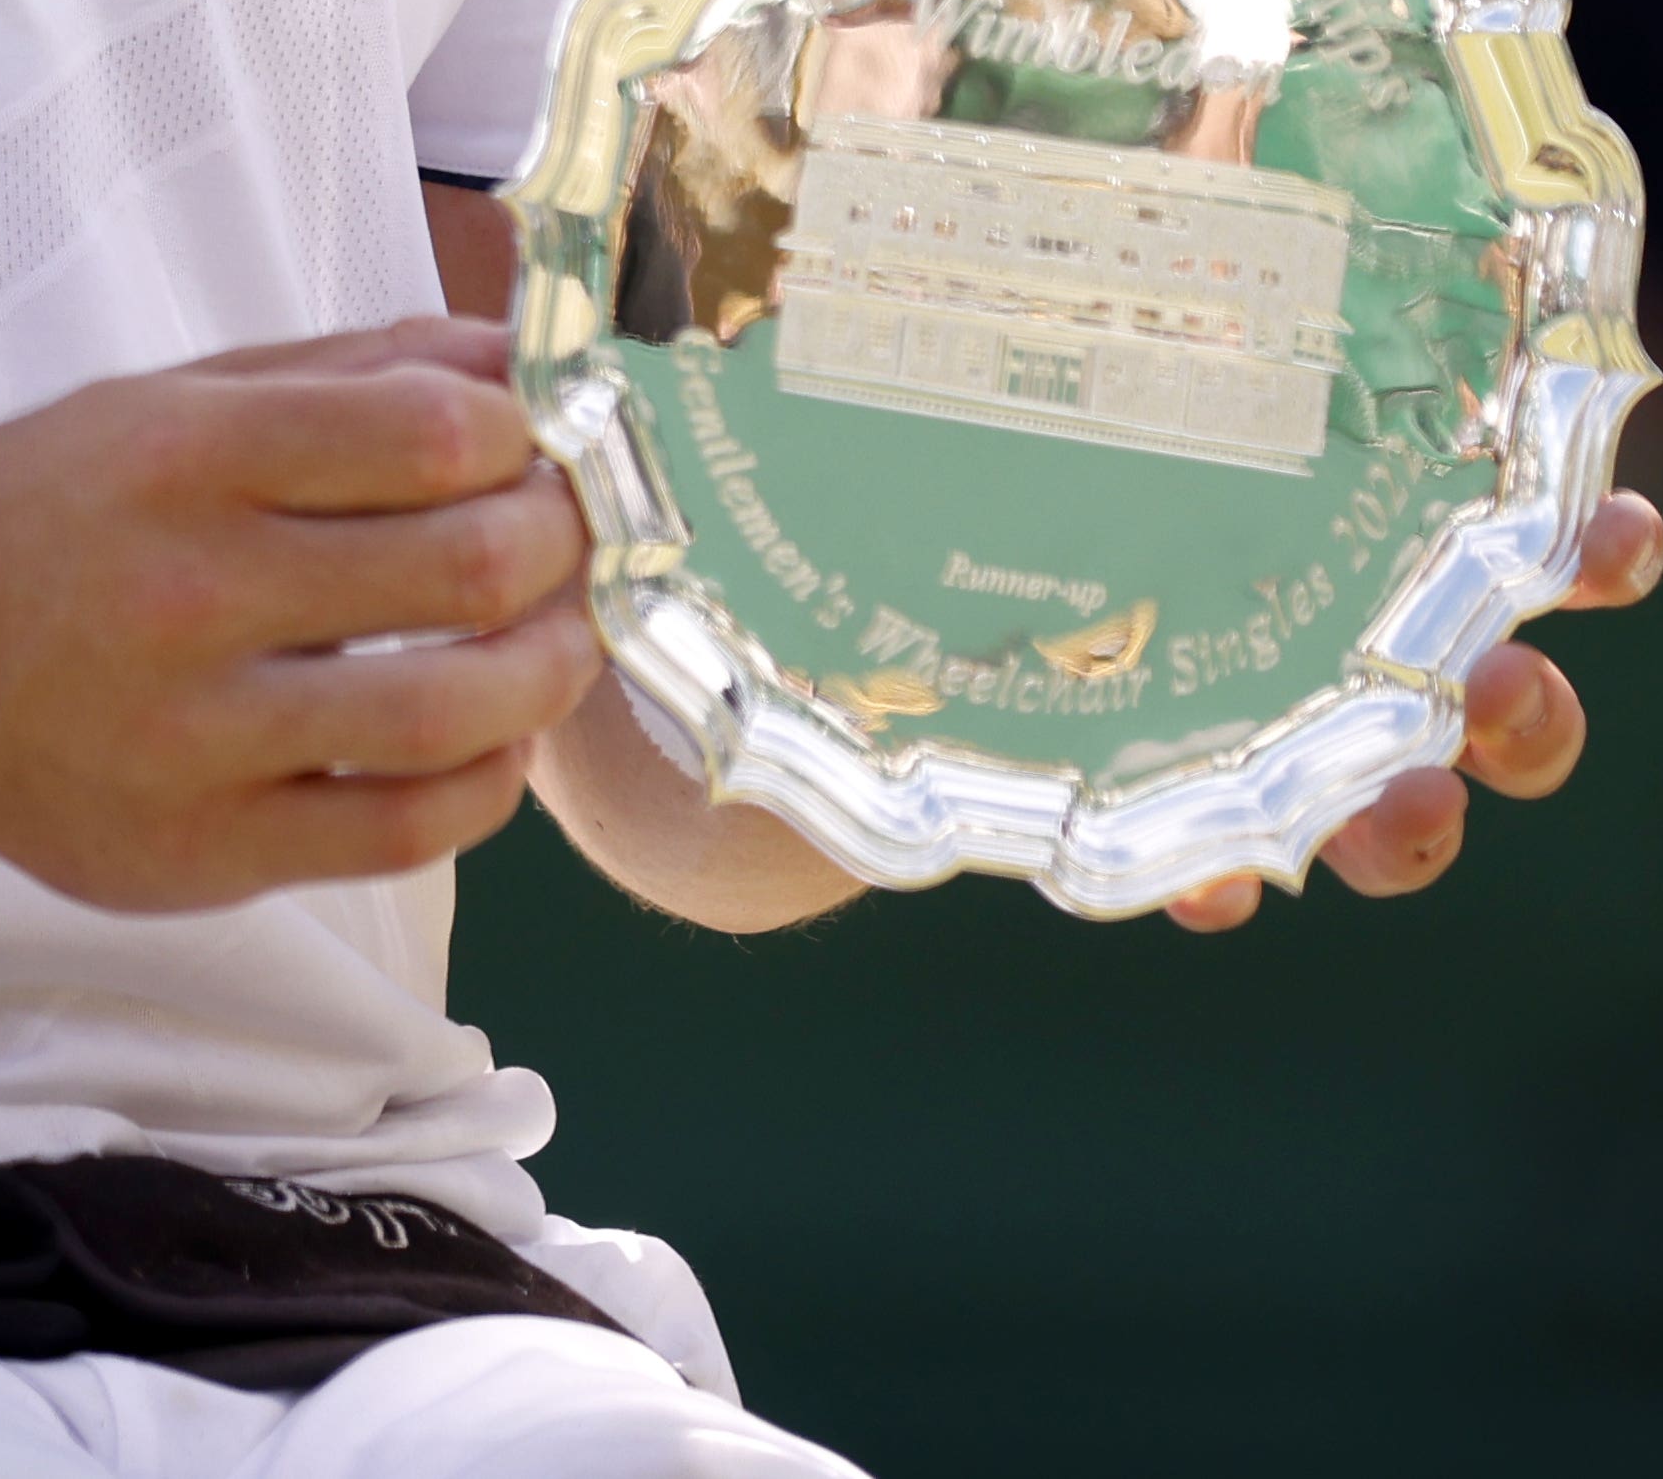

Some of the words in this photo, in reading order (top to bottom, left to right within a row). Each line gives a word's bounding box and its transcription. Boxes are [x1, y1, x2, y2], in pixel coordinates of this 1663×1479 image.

[675, 326, 855, 627] Gentlemen's
[857, 603, 1153, 714] Wheelchair
[1168, 563, 1335, 695] Singles
[942, 548, 1108, 618] Runner-up
